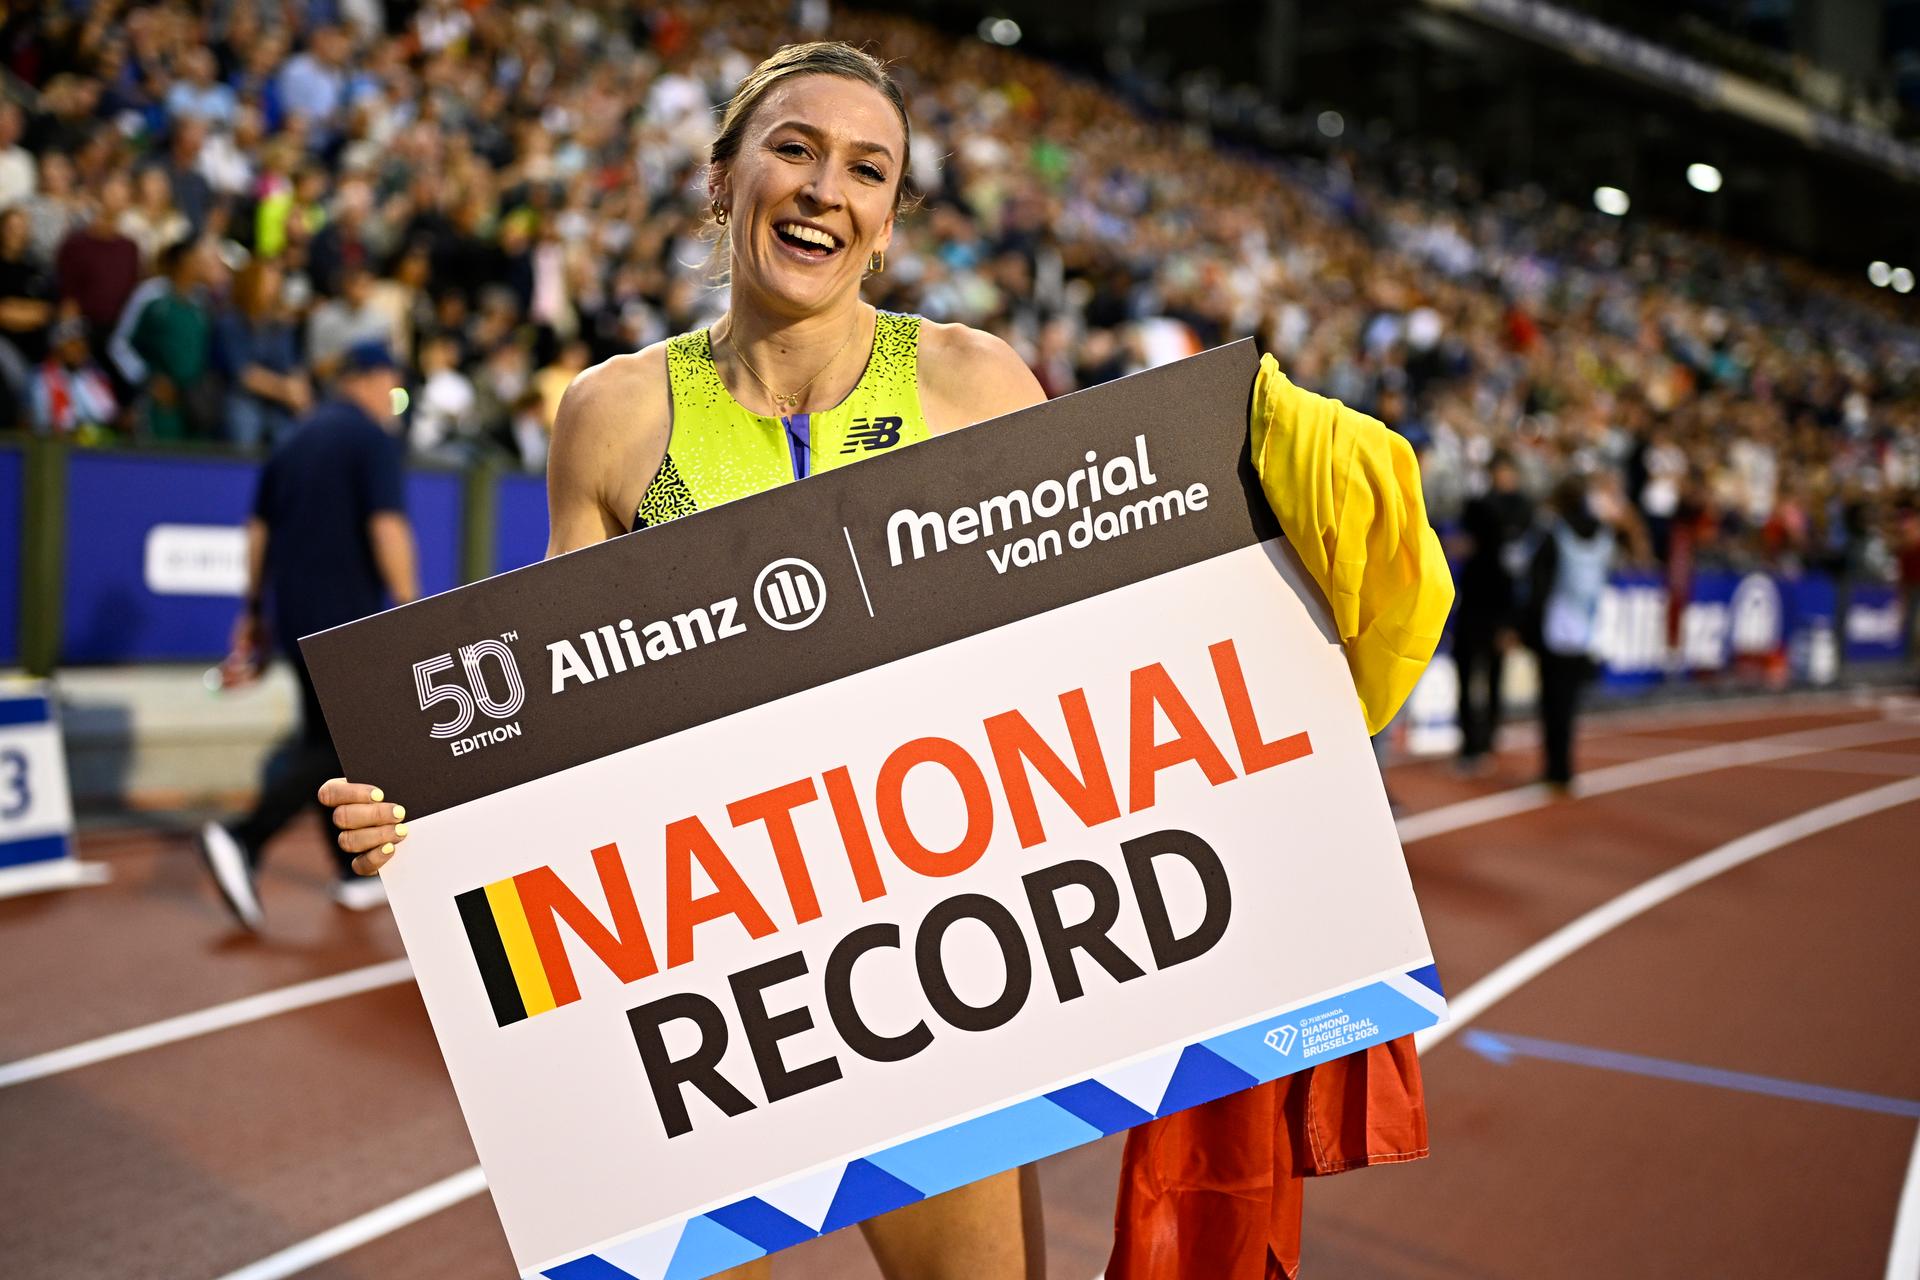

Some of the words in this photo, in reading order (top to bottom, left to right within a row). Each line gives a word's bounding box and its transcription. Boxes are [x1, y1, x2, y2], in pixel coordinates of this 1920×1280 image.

[986, 538, 1062, 574] van
[1068, 483, 1208, 551] damme
[546, 594, 747, 694] Allianz
[451, 722, 522, 756] EDITION
[512, 639, 1313, 1009] NATIONAL
[626, 830, 1231, 1139] RECORD
[1302, 1014, 1350, 1037] DIAMOND
[1302, 1027, 1342, 1048] LEAGUE
[1343, 1018, 1373, 1034] FINAL
[1303, 1033, 1354, 1058] BRUSSELS
[1354, 1025, 1379, 1041] 2026
